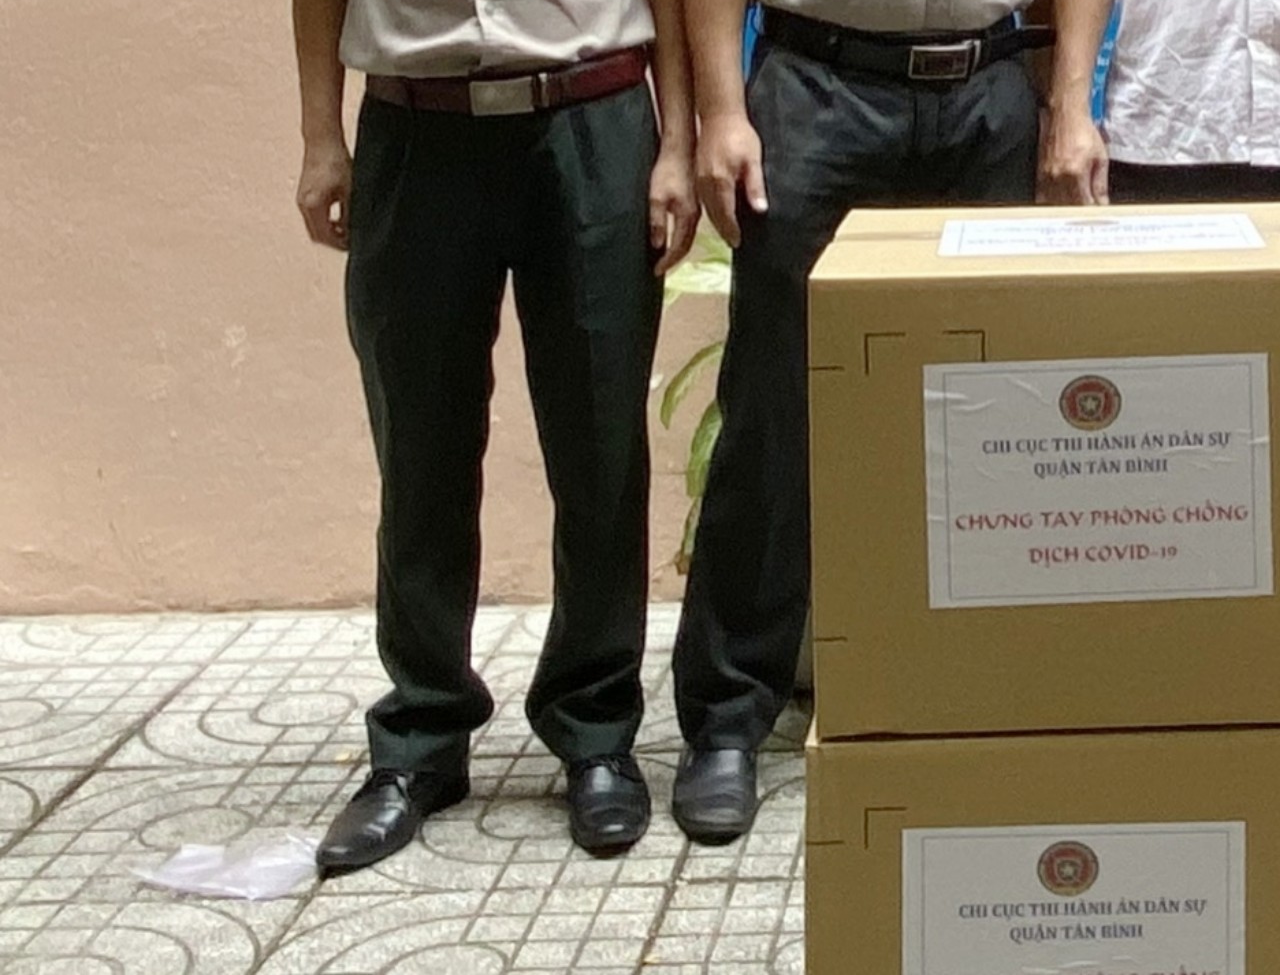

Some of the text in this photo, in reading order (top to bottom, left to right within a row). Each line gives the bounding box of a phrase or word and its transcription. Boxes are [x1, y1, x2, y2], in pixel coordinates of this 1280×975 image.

[981, 439, 1012, 455] CHI
[1014, 438, 1049, 456] CỤC
[1050, 436, 1083, 452] THI
[1139, 432, 1164, 449] ÁN
[1167, 430, 1204, 447] DÂN
[1207, 431, 1232, 448] SỰ
[1033, 459, 1082, 479] QUẬN
[1085, 457, 1121, 474] TÂN
[1039, 510, 1084, 528] TAY
[1089, 506, 1167, 527] PHÒNG
[1172, 503, 1248, 524] CHỐNG
[1029, 543, 1178, 567] DỊCH COVID-19
[957, 903, 988, 919] CHI
[991, 902, 1025, 920] CỤC
[1027, 902, 1060, 917] THI
[1115, 897, 1141, 915] ÁN
[1143, 896, 1180, 914] DÂN
[1182, 898, 1208, 916] SỰ
[1009, 923, 1057, 945] QUẬN
[1062, 923, 1096, 940] TÂN
